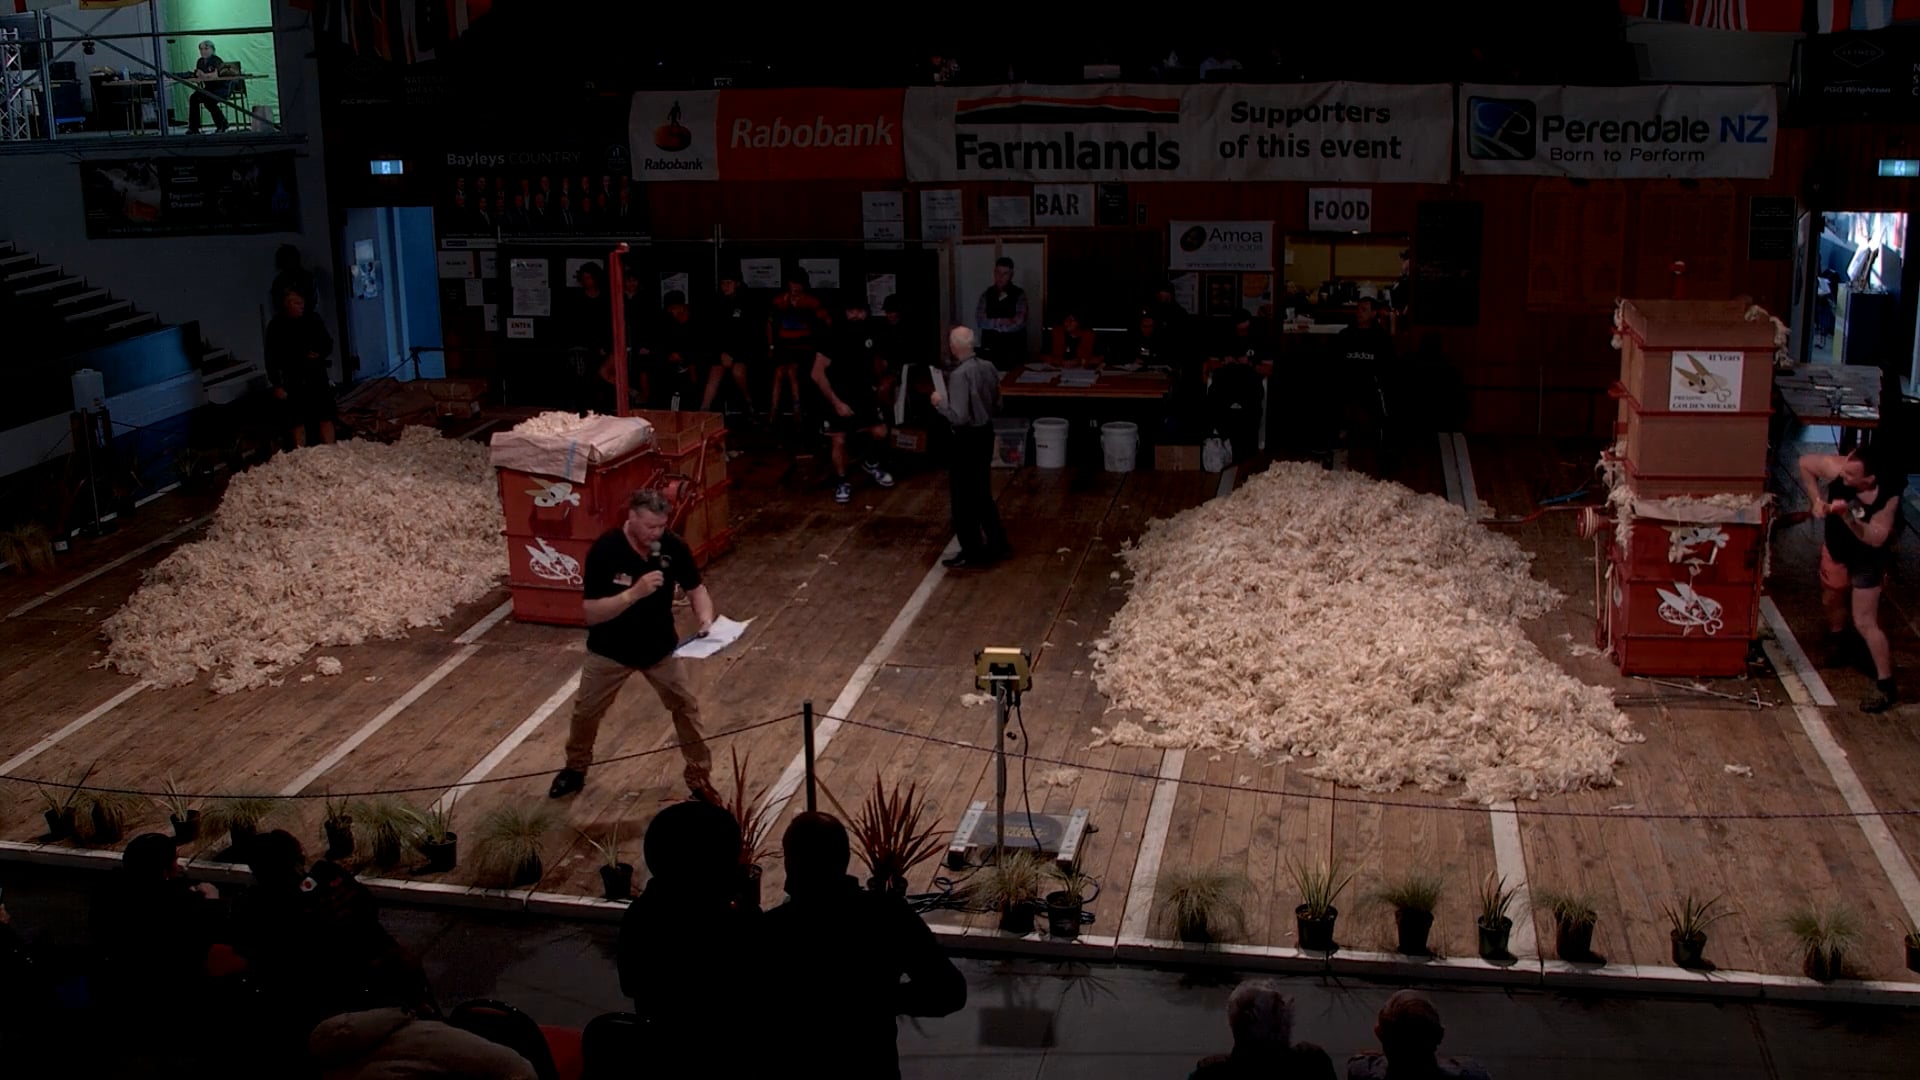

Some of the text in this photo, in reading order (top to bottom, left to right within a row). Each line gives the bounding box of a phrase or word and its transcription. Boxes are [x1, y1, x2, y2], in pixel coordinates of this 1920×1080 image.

[1231, 101, 1391, 128] Supporters
[730, 115, 896, 150] Rabobank
[1542, 115, 1770, 143] Perendale NZ
[955, 131, 1180, 171] Farmlands
[1220, 133, 1402, 160] of this event
[1550, 147, 1705, 162] Born to Perform
[447, 152, 582, 167] Bayleys COUNTRY
[644, 158, 703, 171] Rabobank
[1036, 193, 1079, 215] BAR
[1314, 201, 1369, 221] FOOD
[1209, 227, 1263, 242] Amoa
[1718, 354, 1741, 362] Years
